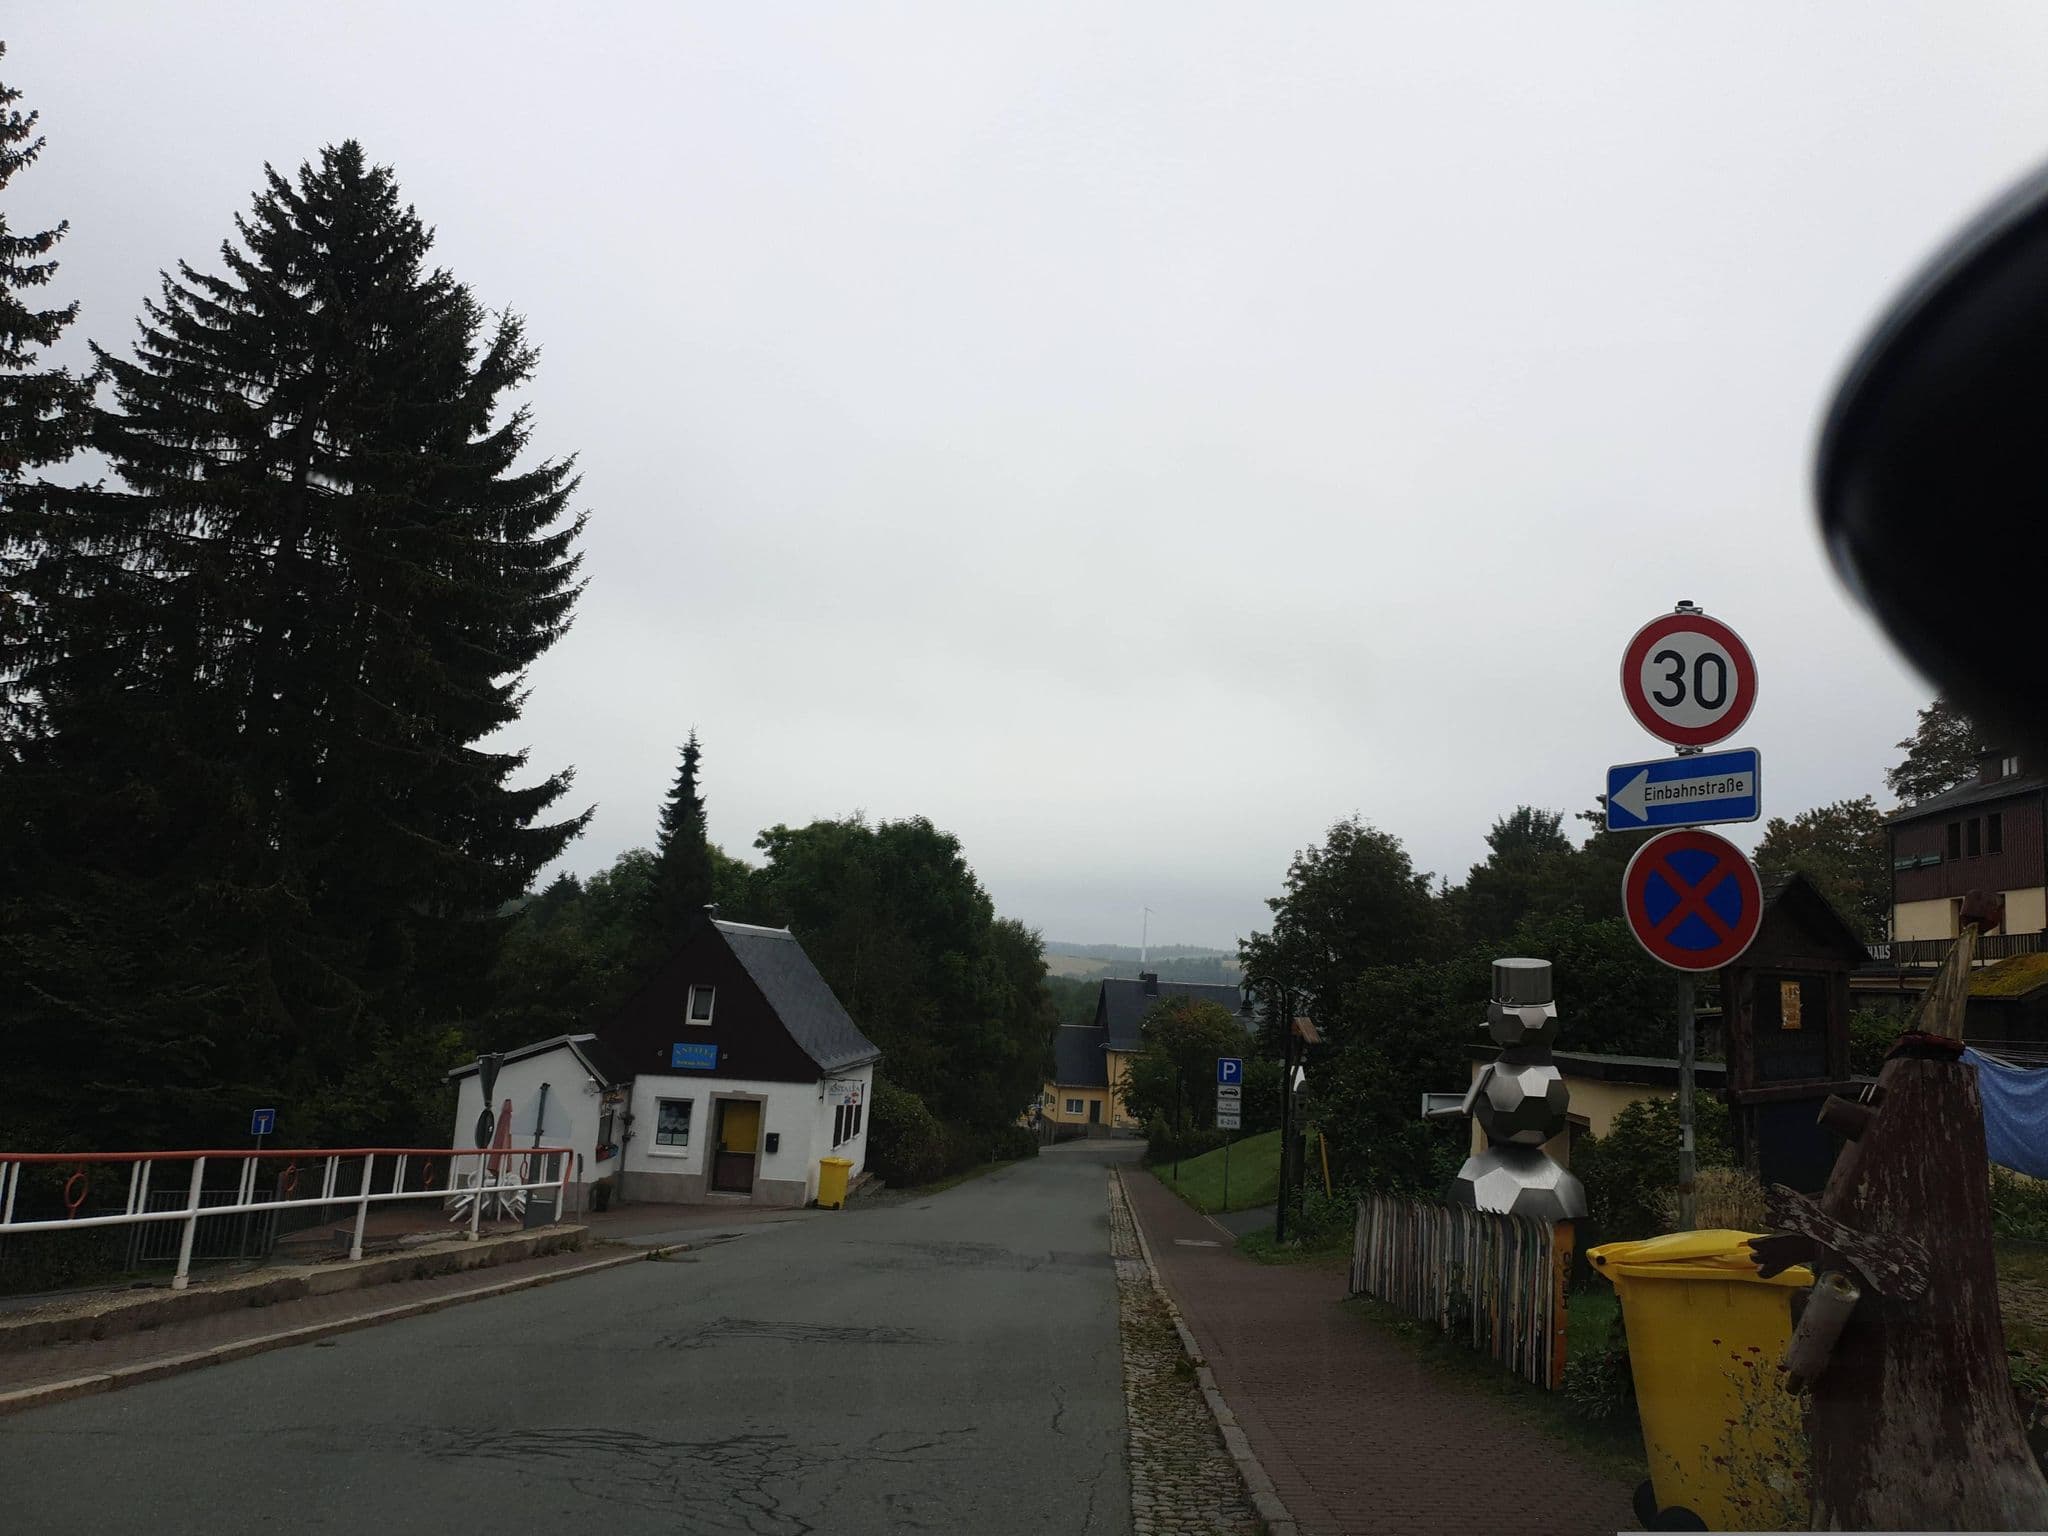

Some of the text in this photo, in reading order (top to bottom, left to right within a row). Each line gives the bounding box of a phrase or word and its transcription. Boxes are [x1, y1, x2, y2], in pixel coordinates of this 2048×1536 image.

[1652, 649, 1727, 710] 30
[1644, 778, 1744, 801] Einbahnstraße
[1223, 1061, 1237, 1080] P
